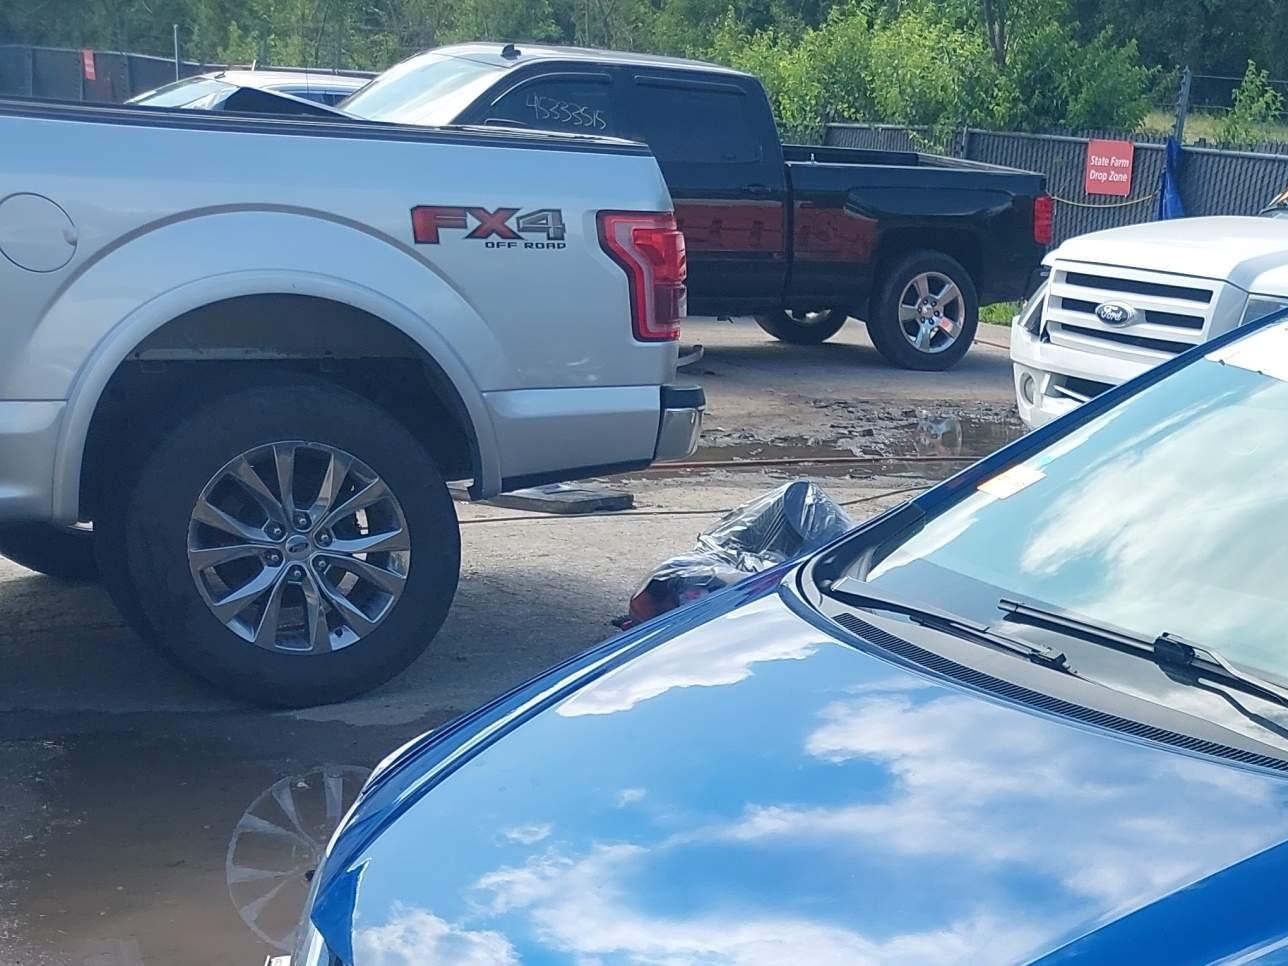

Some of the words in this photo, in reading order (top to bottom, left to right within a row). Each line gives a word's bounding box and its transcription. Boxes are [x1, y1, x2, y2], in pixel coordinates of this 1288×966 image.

[1090, 155, 1109, 166] State
[1110, 156, 1129, 167] Farm
[1089, 169, 1108, 183] Drop
[1108, 170, 1128, 182] Zone
[410, 205, 566, 244] FX4
[485, 241, 517, 249] OFF
[524, 242, 567, 250] ROAD
[1100, 305, 1123, 321] Ford
